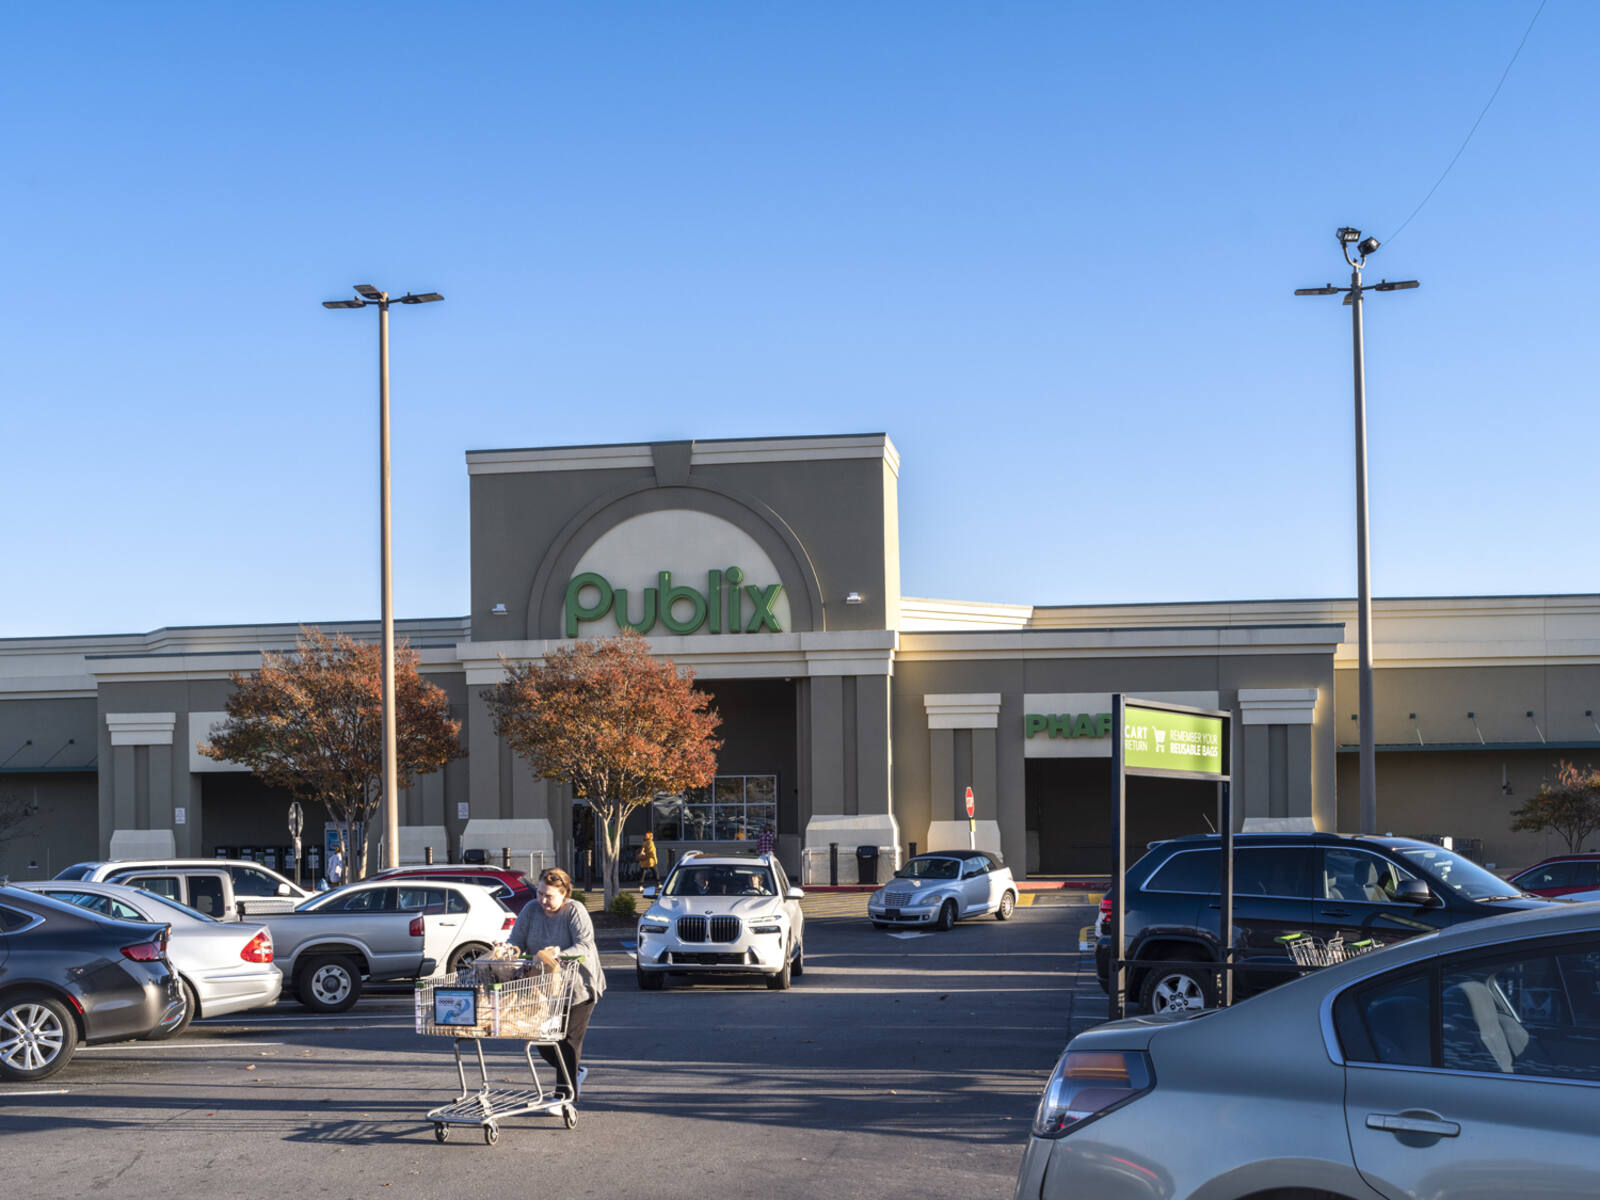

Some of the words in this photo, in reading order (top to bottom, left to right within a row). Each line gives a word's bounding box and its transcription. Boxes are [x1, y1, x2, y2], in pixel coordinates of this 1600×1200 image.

[565, 566, 783, 638] Publix
[1124, 725, 1148, 739] CART
[1170, 729, 1202, 743] REMEMBER
[1203, 733, 1218, 745] YOUR
[1170, 742, 1201, 756] REUSABLE
[1202, 744, 1218, 757] BAGS
